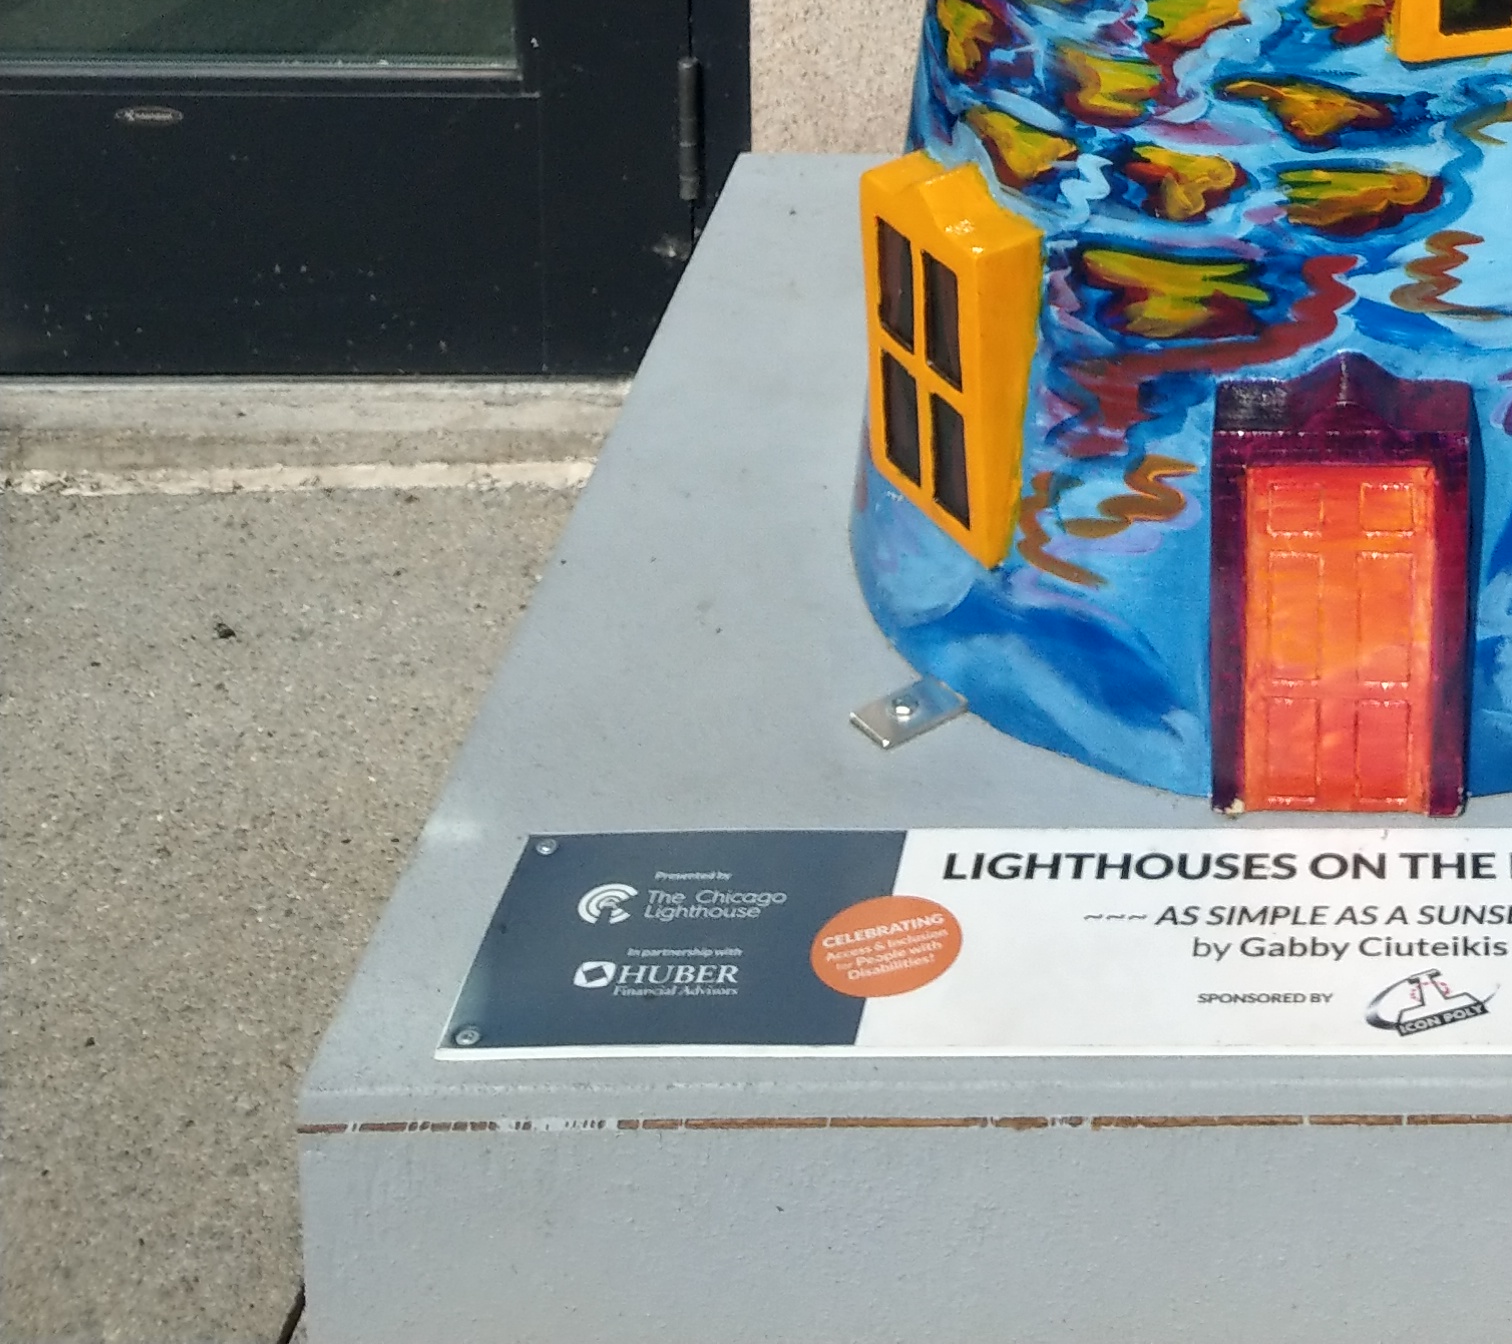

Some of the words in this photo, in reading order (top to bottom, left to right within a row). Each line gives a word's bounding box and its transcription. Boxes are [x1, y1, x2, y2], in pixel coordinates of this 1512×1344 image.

[942, 852, 1297, 880] LIGHTHOUSES
[1309, 852, 1386, 879] ON
[1399, 852, 1496, 879] THE
[648, 890, 686, 904] The
[696, 889, 787, 907] Chicago
[644, 904, 761, 922] Lighthouse
[1154, 905, 1200, 926] AS
[1205, 905, 1329, 926] SIMPLE
[1334, 905, 1378, 925] AS
[1385, 905, 1409, 925] A
[822, 913, 945, 948] CELEBRATING
[1192, 937, 1231, 961] by
[1240, 937, 1350, 961] Gabby
[1359, 935, 1508, 957] Ciuteikis
[617, 965, 739, 984] HUBER
[1197, 993, 1306, 1003] SPONSORED
[1310, 993, 1333, 1003] BY
[1400, 1016, 1441, 1033] ICON
[1443, 1004, 1484, 1022] POLY
